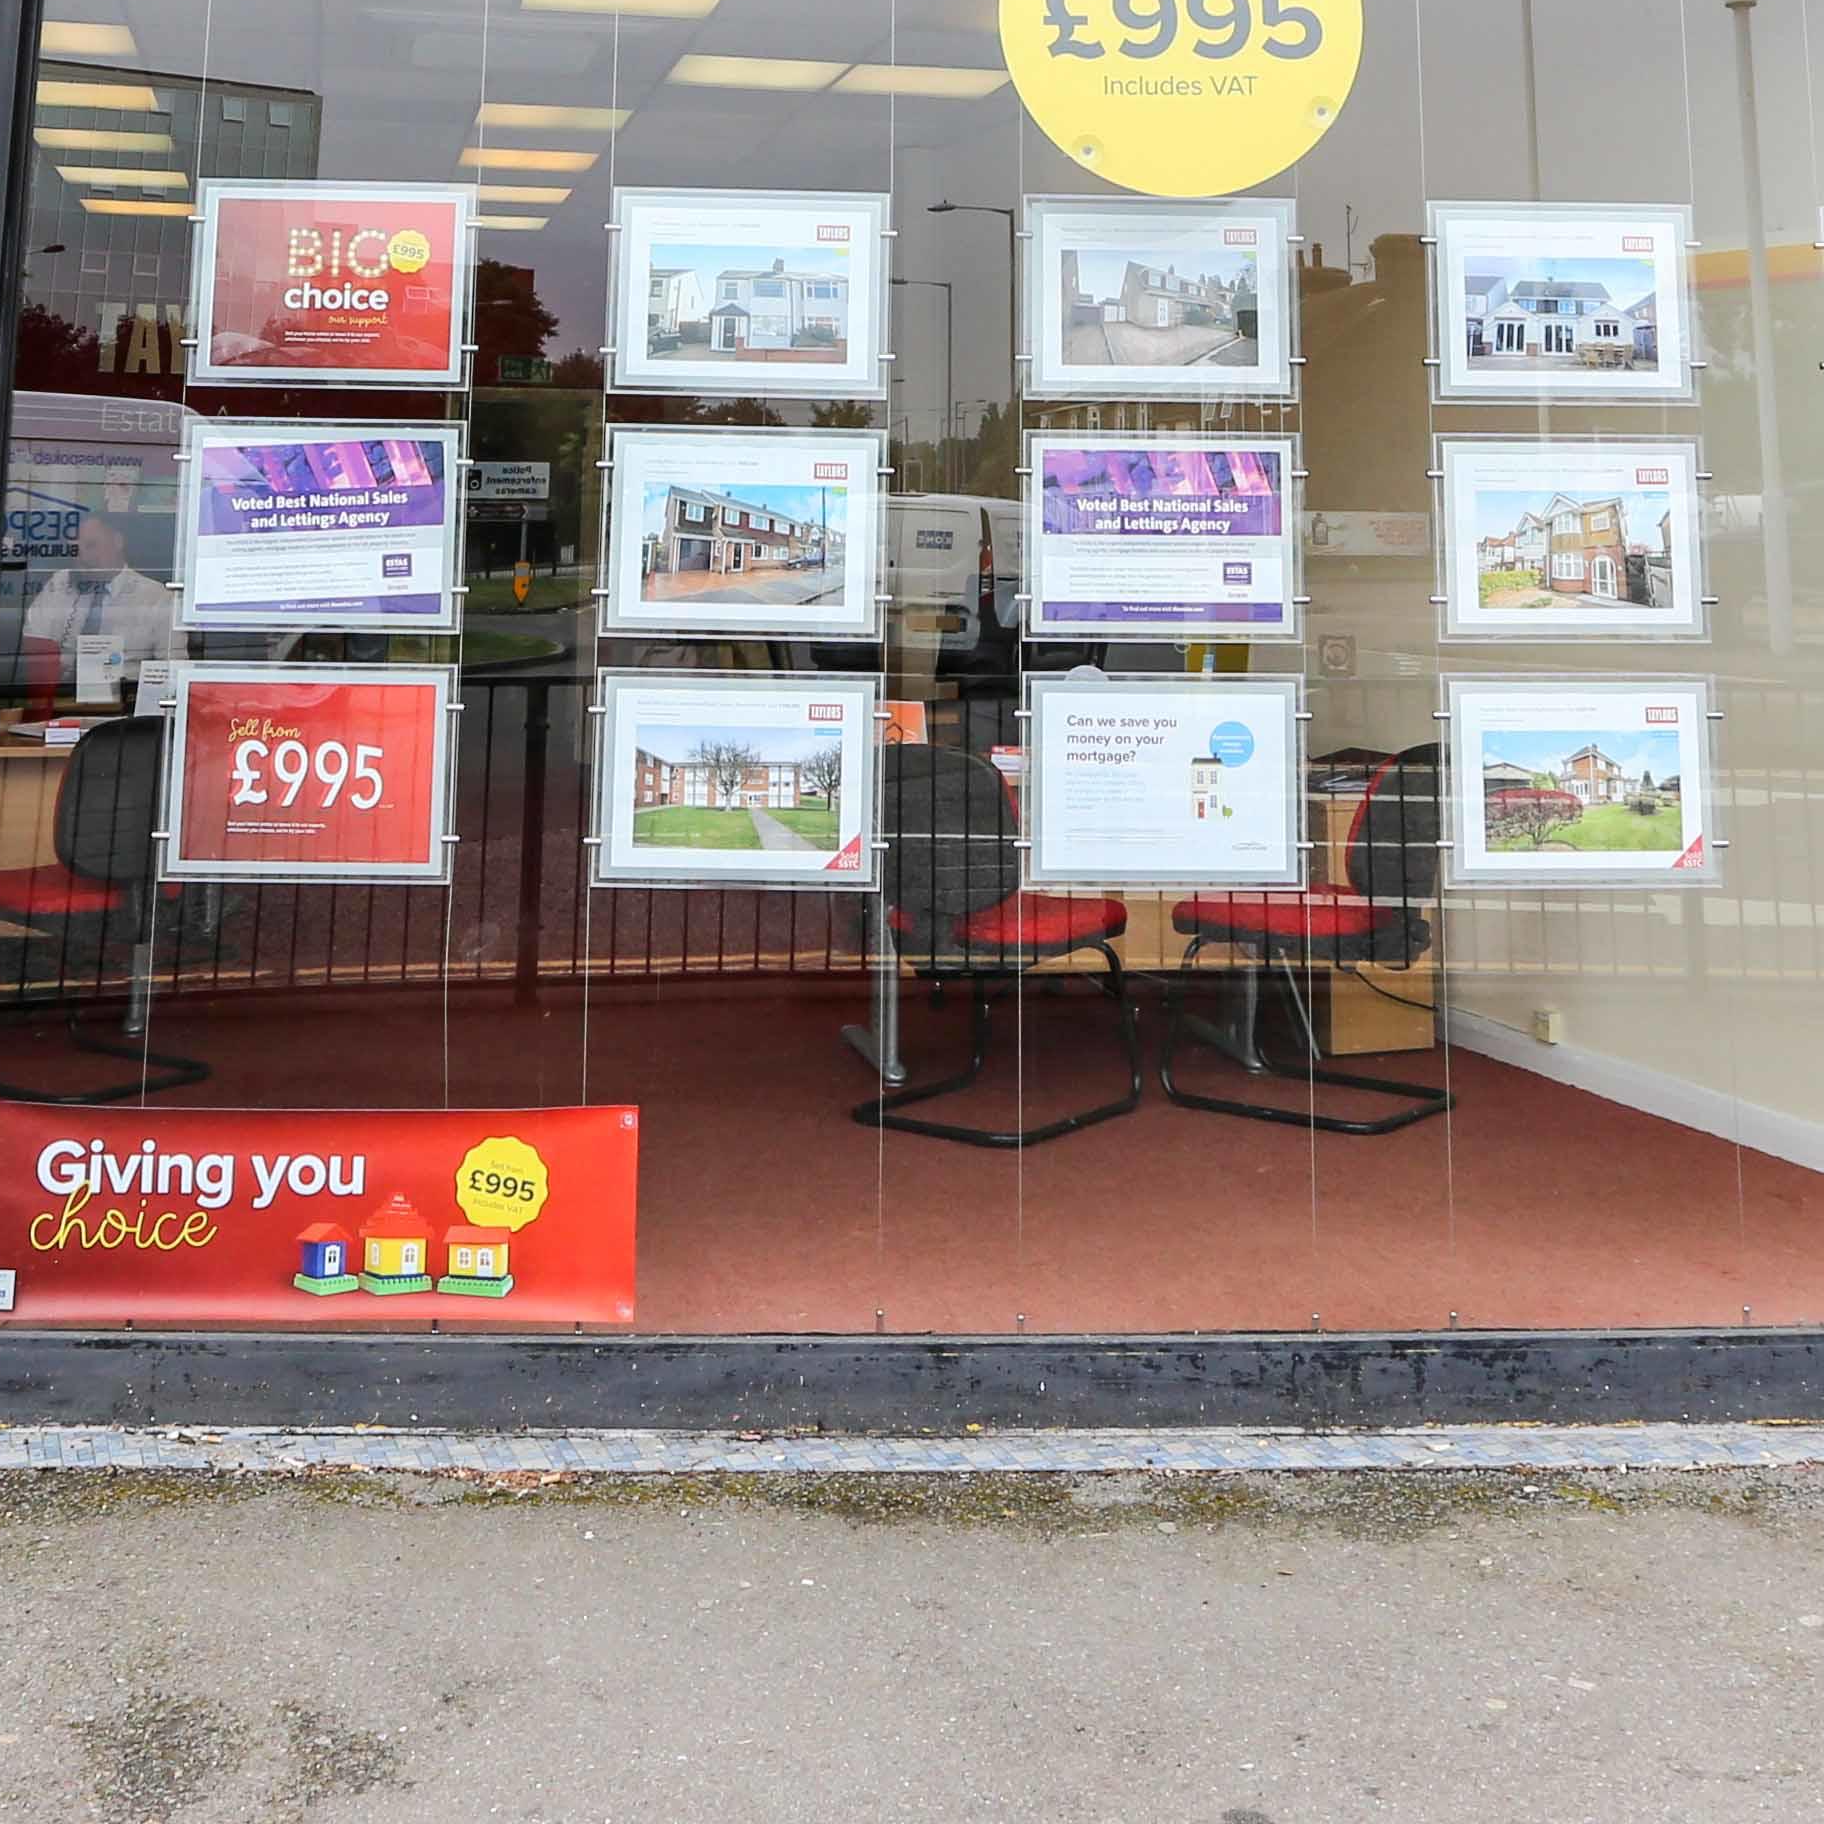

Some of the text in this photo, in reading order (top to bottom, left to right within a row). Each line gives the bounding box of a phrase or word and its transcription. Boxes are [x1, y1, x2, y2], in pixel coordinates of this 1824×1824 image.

[1103, 75, 1259, 96] Includes VAT
[391, 243, 426, 261] £995
[284, 282, 390, 311] choice
[232, 491, 408, 511] Voted Best National Sales
[1076, 498, 1249, 513] Voted Best National Sales
[250, 511, 390, 529] and Lettings Agency
[1095, 516, 1231, 534] and Lettings Agency
[227, 718, 302, 742] Sell from
[1066, 714, 1177, 730] Can we save you
[1066, 734, 1165, 747] money on your
[1066, 750, 1137, 764] mortgage?
[230, 739, 384, 810] £995
[36, 1138, 367, 1210] Giving you
[469, 1169, 536, 1202] £995
[28, 1179, 217, 1251] choice
